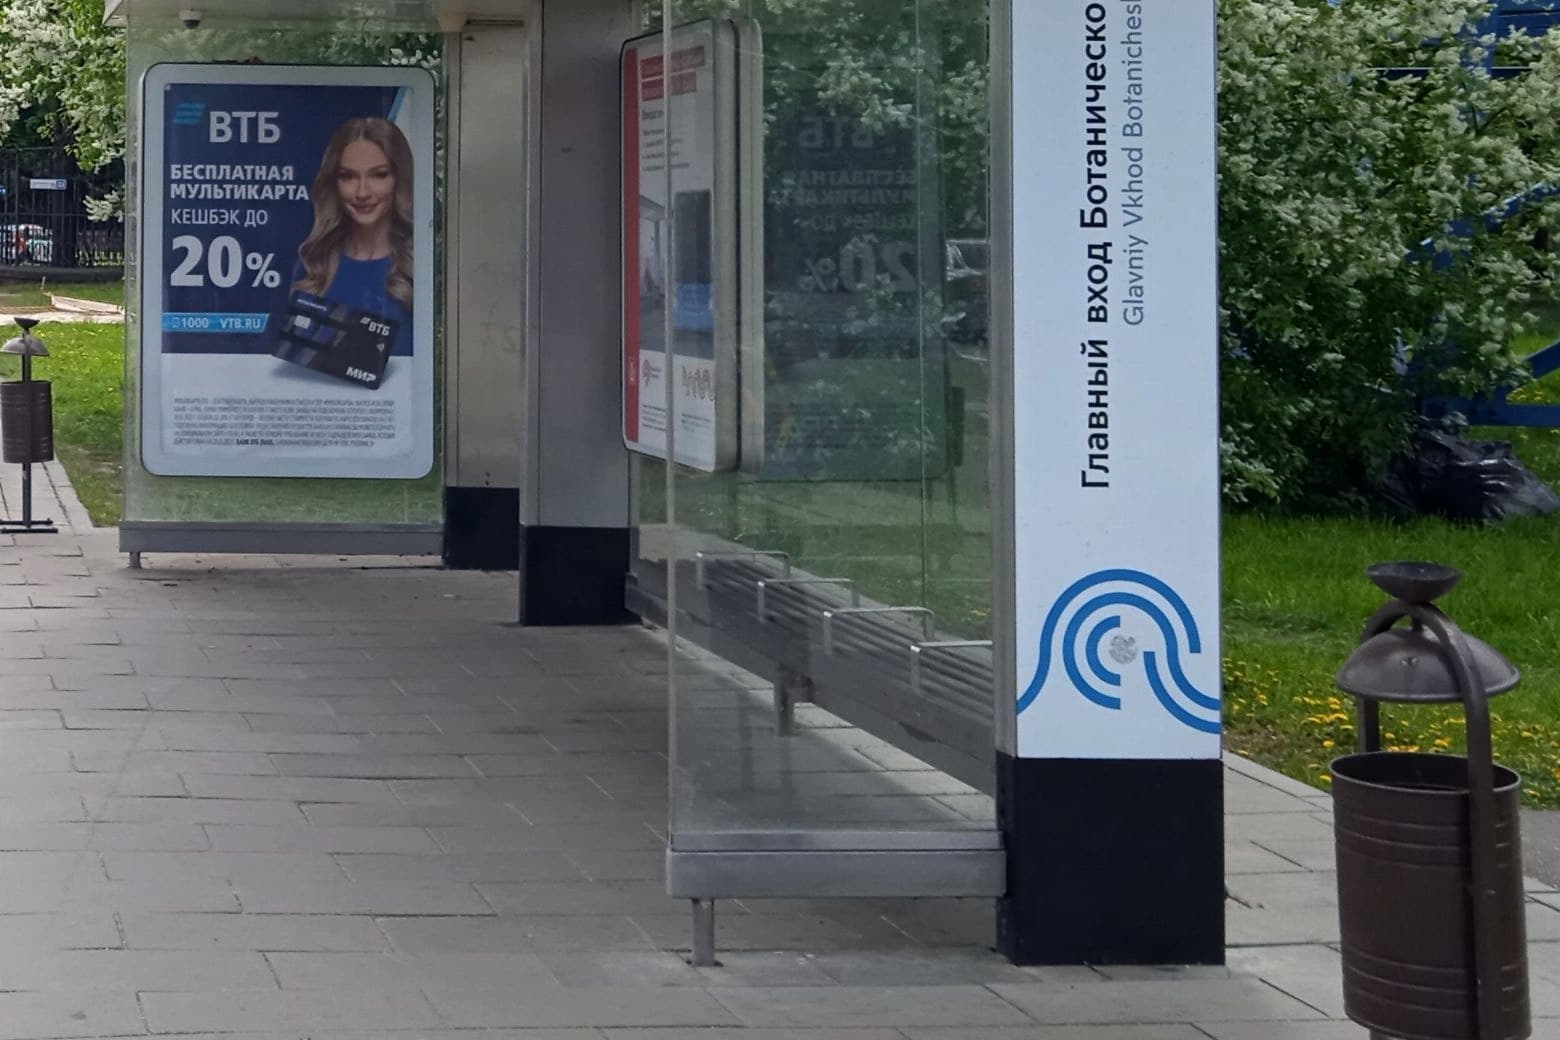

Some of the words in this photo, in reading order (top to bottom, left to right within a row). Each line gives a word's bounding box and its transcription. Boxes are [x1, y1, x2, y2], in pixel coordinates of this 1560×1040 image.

[209, 111, 281, 143] ВТБ
[170, 164, 294, 181] БЕСПЛАТНАЯ
[170, 184, 309, 201] МУЛЬТИКАРТА
[1121, 148, 1144, 227] Vkhod
[171, 208, 240, 225] КЕШБЭК
[244, 209, 268, 227] ДО
[170, 235, 281, 288] 20%
[1087, 242, 1113, 323] вход
[1122, 234, 1148, 326] Glavniy
[182, 317, 209, 329] 1000
[219, 318, 261, 329] VTB.RU
[368, 320, 390, 336] ВТБ
[346, 366, 377, 383] МИР
[1080, 339, 1109, 488] Главный
